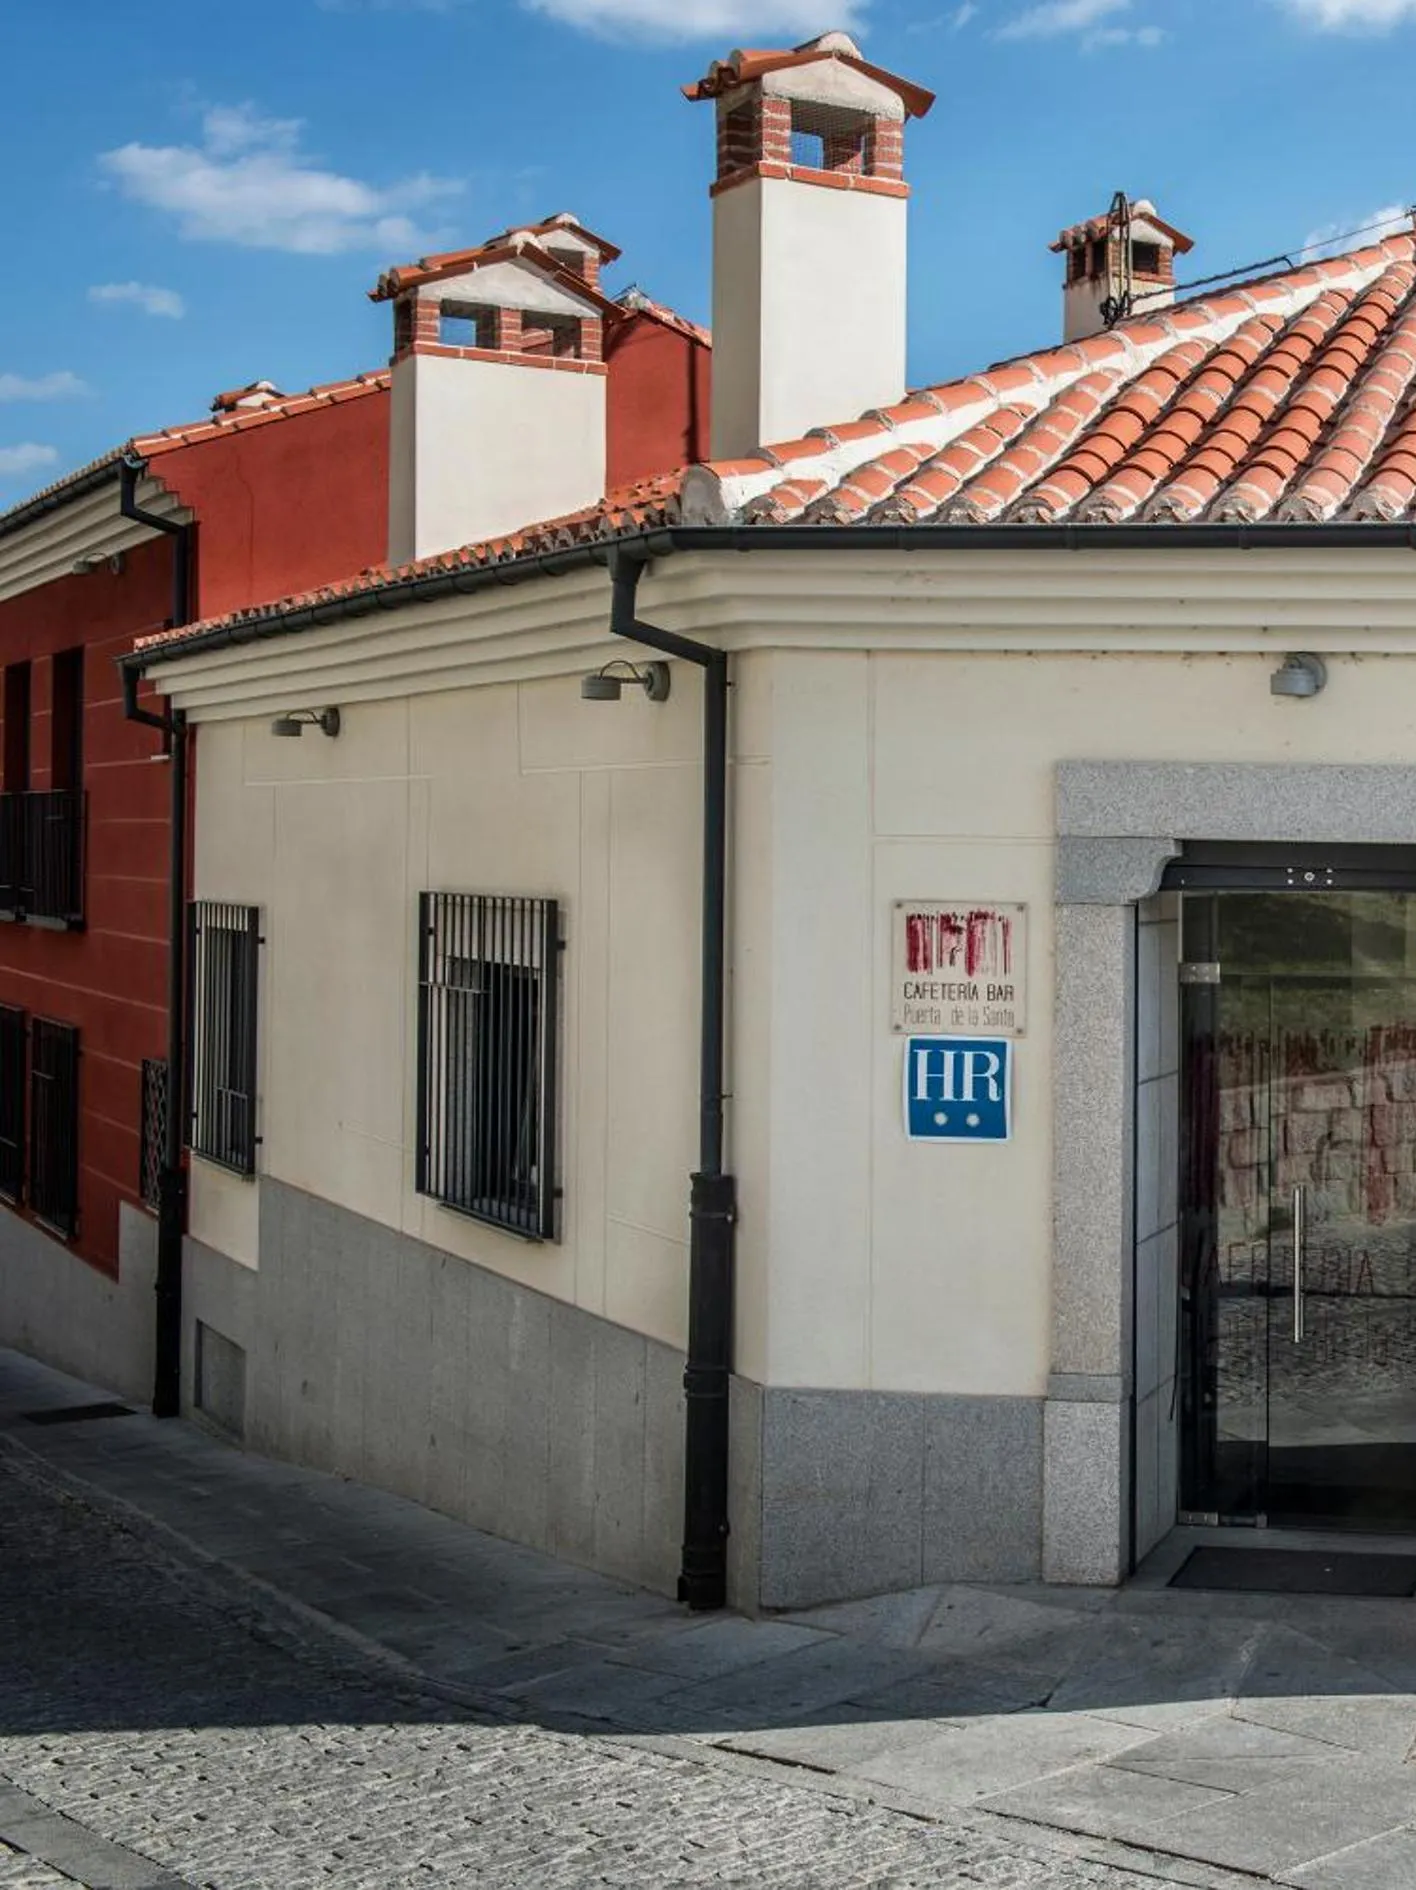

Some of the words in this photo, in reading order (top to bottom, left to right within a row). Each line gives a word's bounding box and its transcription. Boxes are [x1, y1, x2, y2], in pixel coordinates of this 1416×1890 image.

[986, 983, 1014, 1002] BAR
[903, 1003, 941, 1025] Puerta
[951, 1005, 964, 1026] de
[968, 1005, 979, 1027] la
[911, 1048, 1001, 1102] HR
